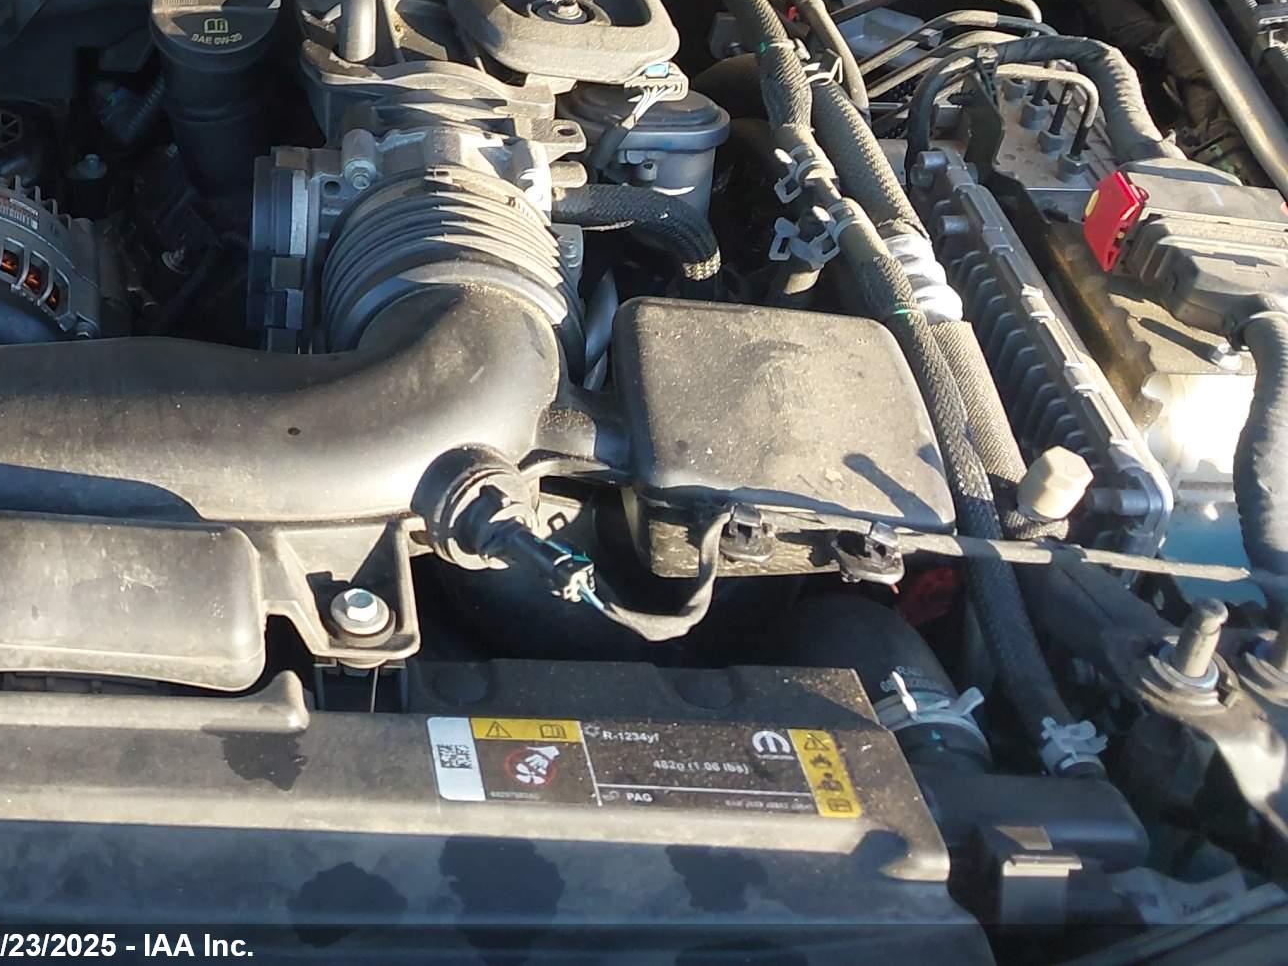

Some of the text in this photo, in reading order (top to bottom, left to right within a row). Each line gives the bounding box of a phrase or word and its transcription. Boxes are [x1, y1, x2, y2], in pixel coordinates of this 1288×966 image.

[190, 32, 243, 45] SAE 0W-20
[602, 730, 660, 745] R-1234yf
[652, 758, 684, 772] 482g
[722, 761, 750, 775] lbs)
[626, 791, 653, 803] PAG
